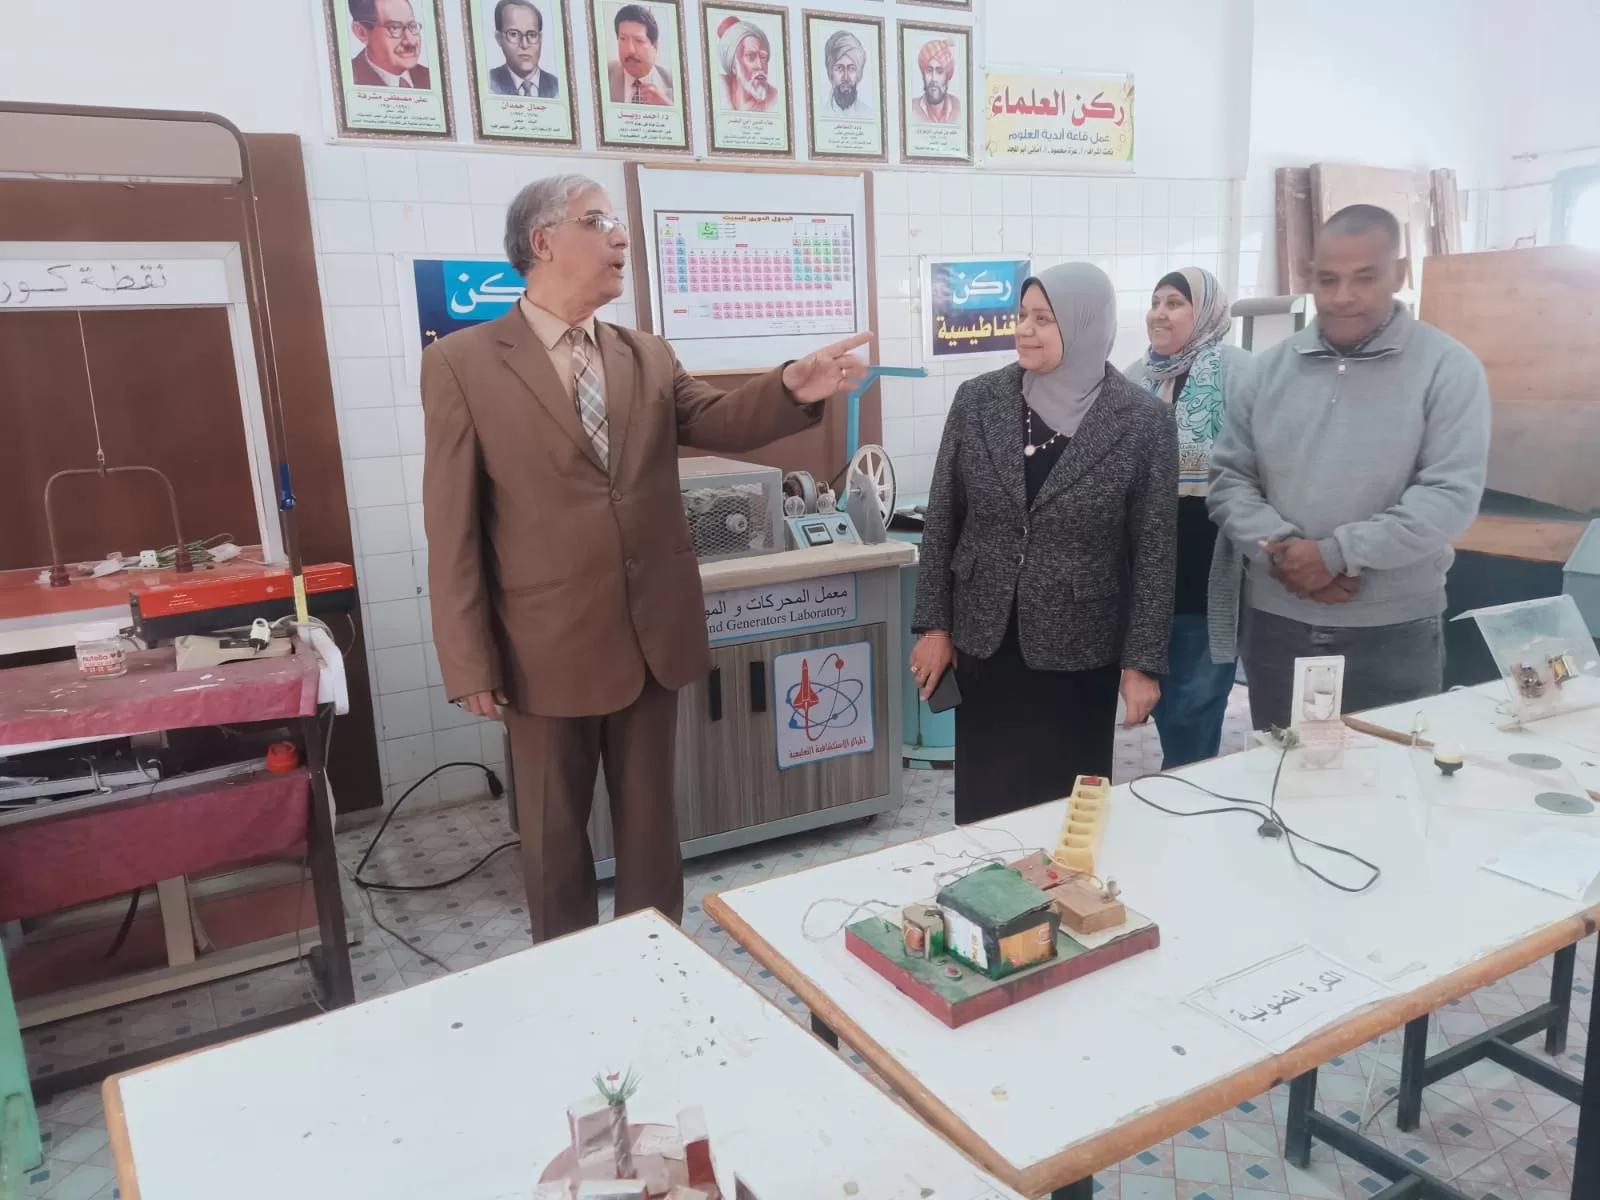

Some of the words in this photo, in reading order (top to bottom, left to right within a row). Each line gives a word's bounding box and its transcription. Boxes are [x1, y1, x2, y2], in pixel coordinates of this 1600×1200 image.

[991, 85, 1066, 117] العلماء
[1072, 91, 1125, 127] ركن
[1008, 128, 1040, 142] العلوم
[1090, 131, 1111, 145] عمل
[0, 263, 72, 304] كور
[80, 263, 167, 294] نقطة
[451, 271, 526, 314] كن
[952, 270, 1013, 305] ركن
[936, 311, 1020, 347] غناطيسية
[745, 588, 810, 611] المحركات
[814, 586, 848, 604] معمل
[707, 621, 724, 634] nd
[726, 614, 787, 632] Generators
[790, 605, 848, 622] Laboratory
[733, 606, 742, 617] و
